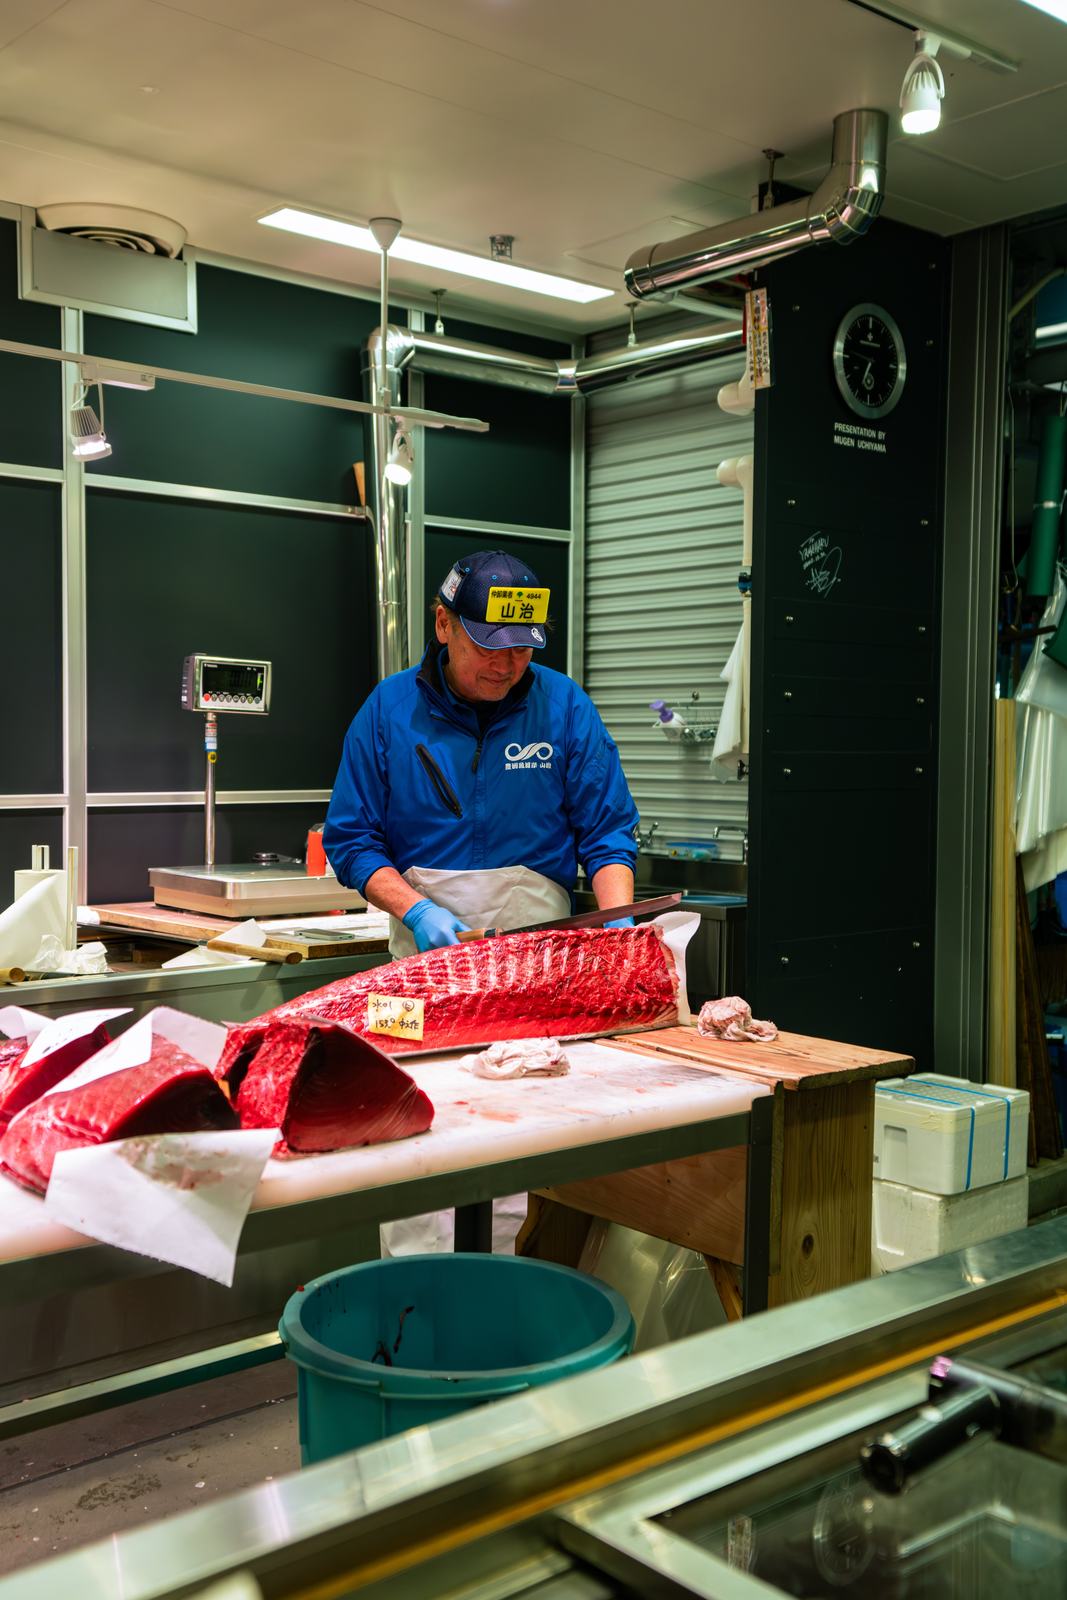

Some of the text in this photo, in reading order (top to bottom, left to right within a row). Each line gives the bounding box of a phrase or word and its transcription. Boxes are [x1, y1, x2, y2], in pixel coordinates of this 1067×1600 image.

[834, 422, 886, 440] PRESENTATION BY
[834, 435, 887, 454] MUGEN UCHIYAMA
[501, 602, 534, 619] 山治
